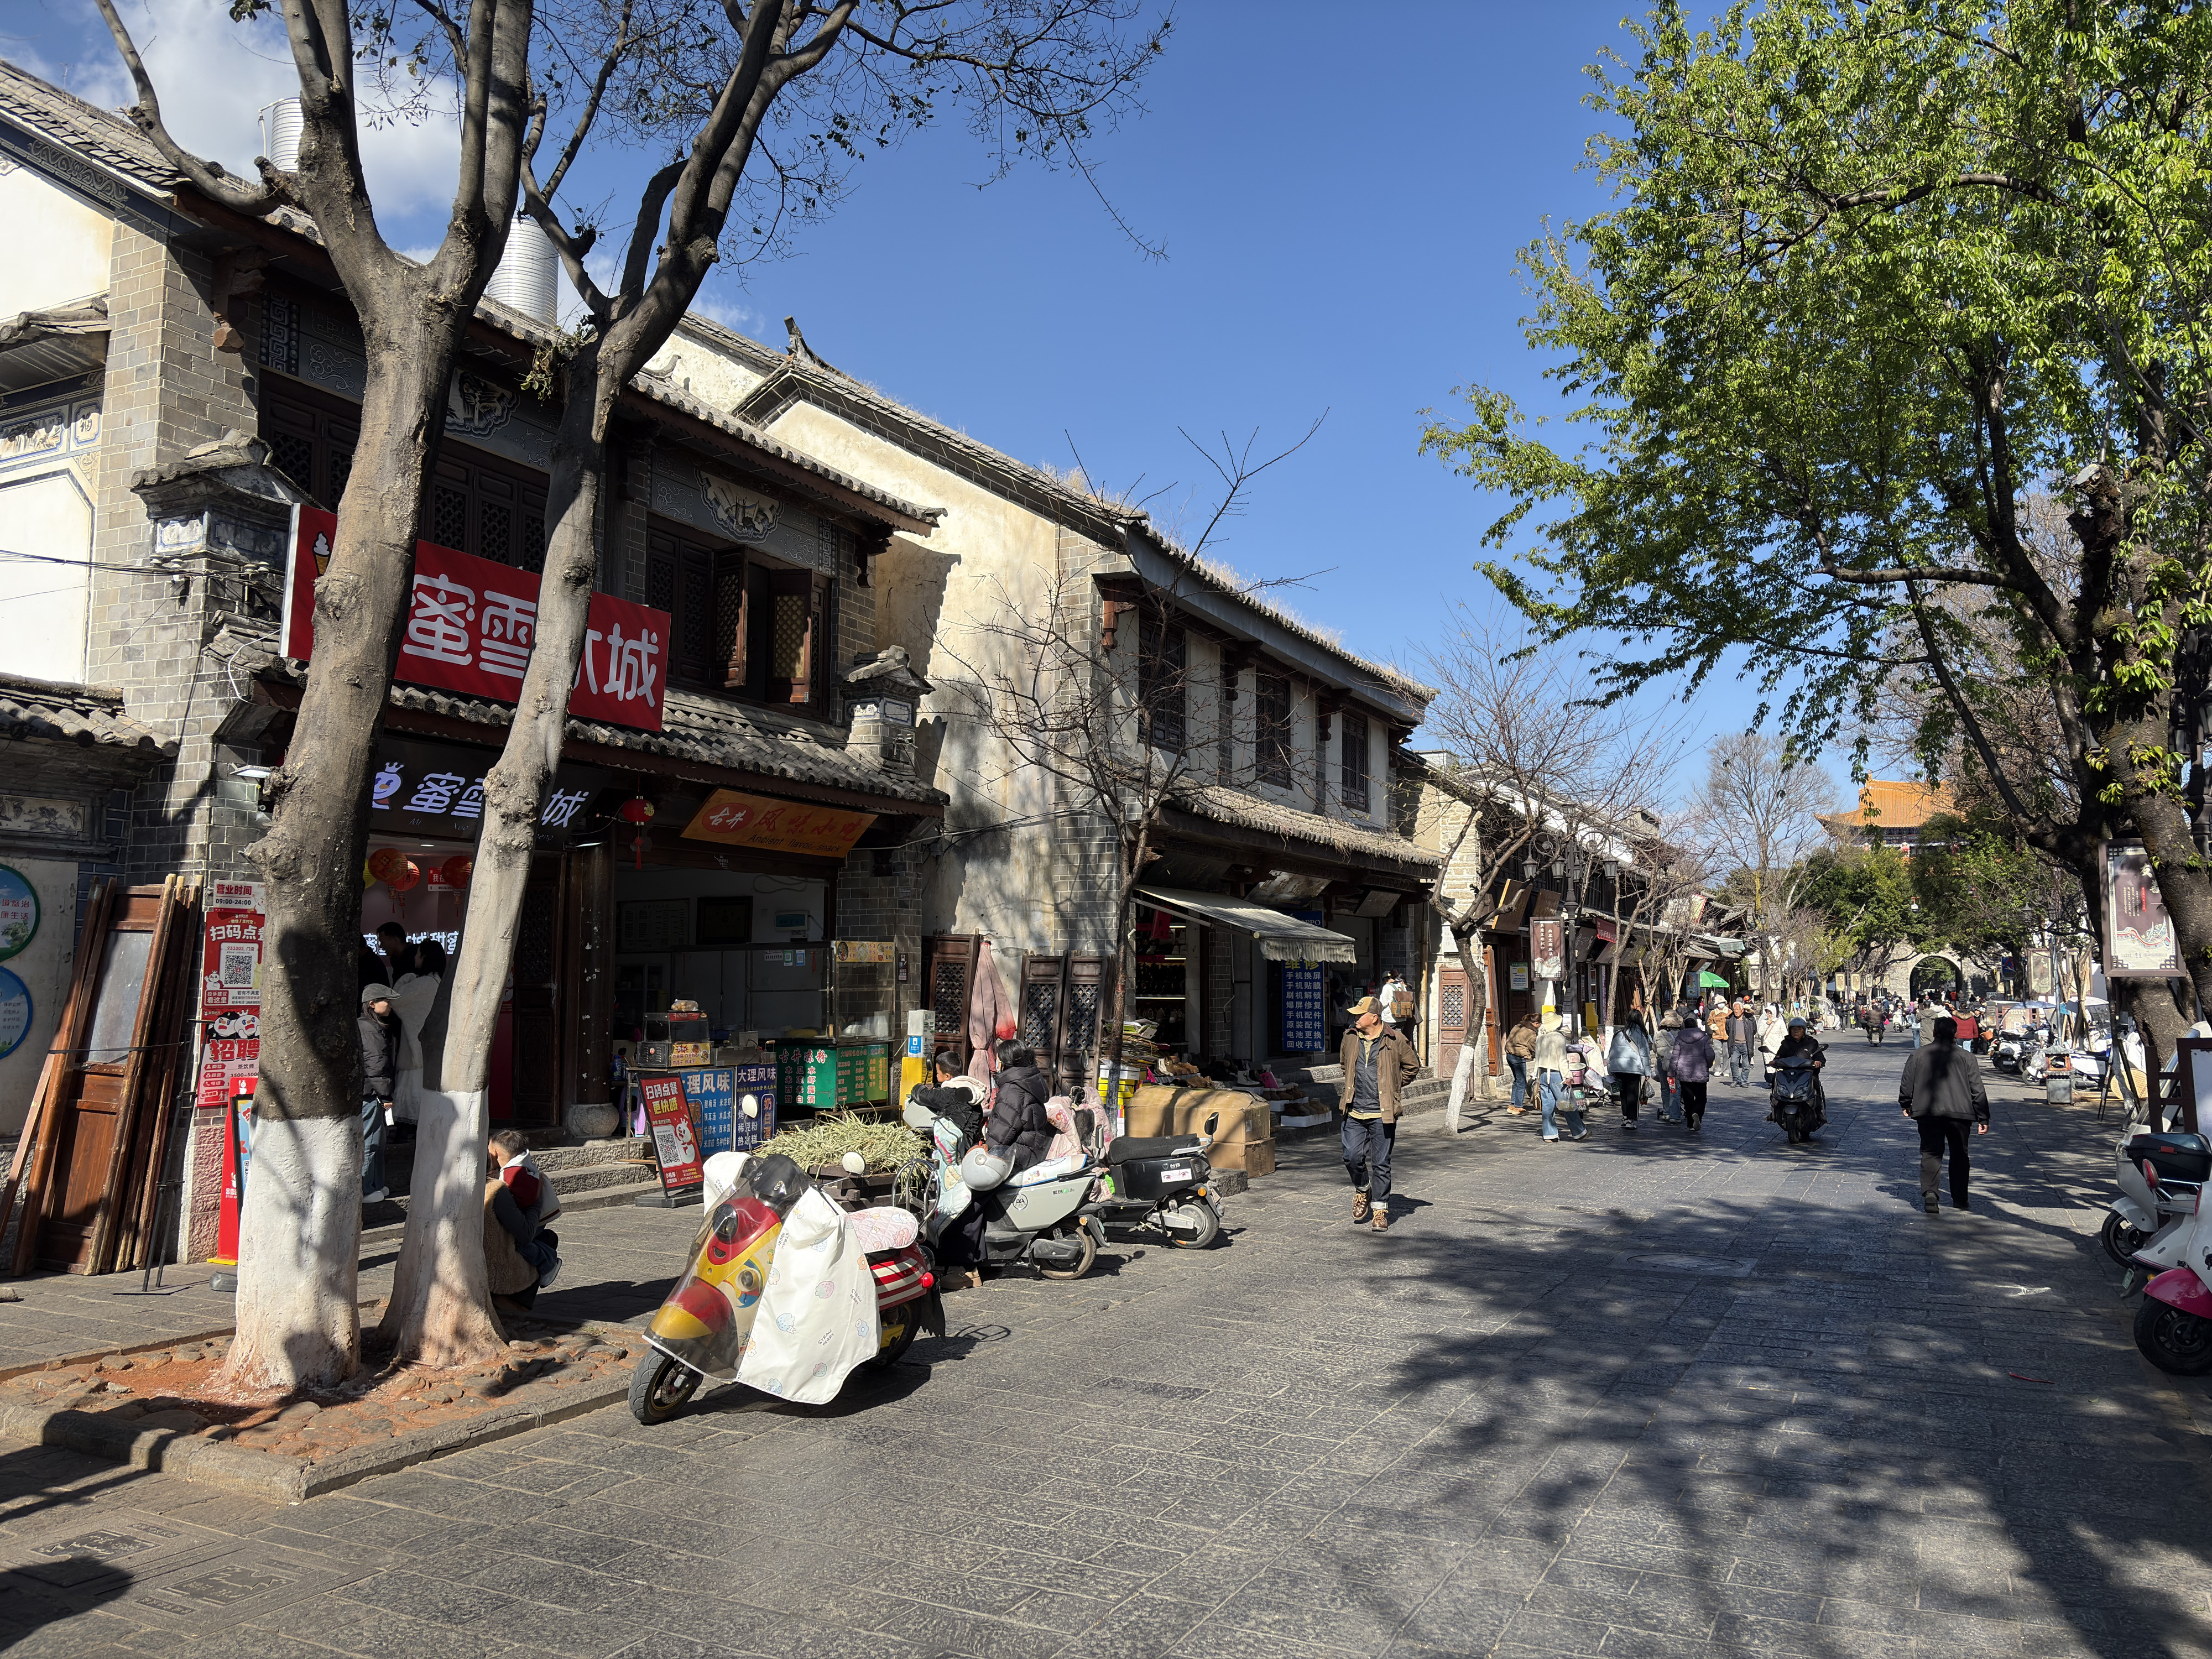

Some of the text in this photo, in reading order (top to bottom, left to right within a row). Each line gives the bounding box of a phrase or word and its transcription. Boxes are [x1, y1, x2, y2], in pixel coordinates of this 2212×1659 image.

[709, 806, 747, 829] 古井
[752, 807, 863, 841] 风味小吃
[748, 833, 841, 852] Ancient flavor snack
[216, 884, 252, 895] 营业时间
[1286, 972, 1321, 980] 手机换屏
[1286, 982, 1321, 990] 手机贴膜
[1286, 992, 1321, 1000] 刷机解锁
[1286, 1001, 1322, 1009] 爆屏修复
[1286, 1011, 1322, 1019] 手机配件
[1286, 1021, 1322, 1029] 原装配件
[1287, 1031, 1322, 1039] 电池更换
[1287, 1041, 1322, 1049] 回收手机
[210, 1039, 259, 1062] 招聘
[779, 1048, 828, 1065] 古井凉粉
[738, 1067, 777, 1083] 大理风味
[785, 1066, 816, 1075] 木瓜水
[682, 1072, 731, 1094] 理风味
[785, 1075, 816, 1084] 米凉虾
[645, 1082, 679, 1100] 扫码点餐
[784, 1085, 816, 1094] 西米露
[704, 1099, 717, 1108] 酸梅汤
[784, 1094, 816, 1104] 甜白酒
[652, 1097, 679, 1115] 更快哦
[704, 1112, 717, 1121] 银耳汤
[719, 1111, 731, 1120] 木瓜水
[763, 1097, 773, 1139] 奶白酒
[704, 1124, 731, 1135] 柠檬水 西米露
[818, 1329, 832, 1344] STRAW
